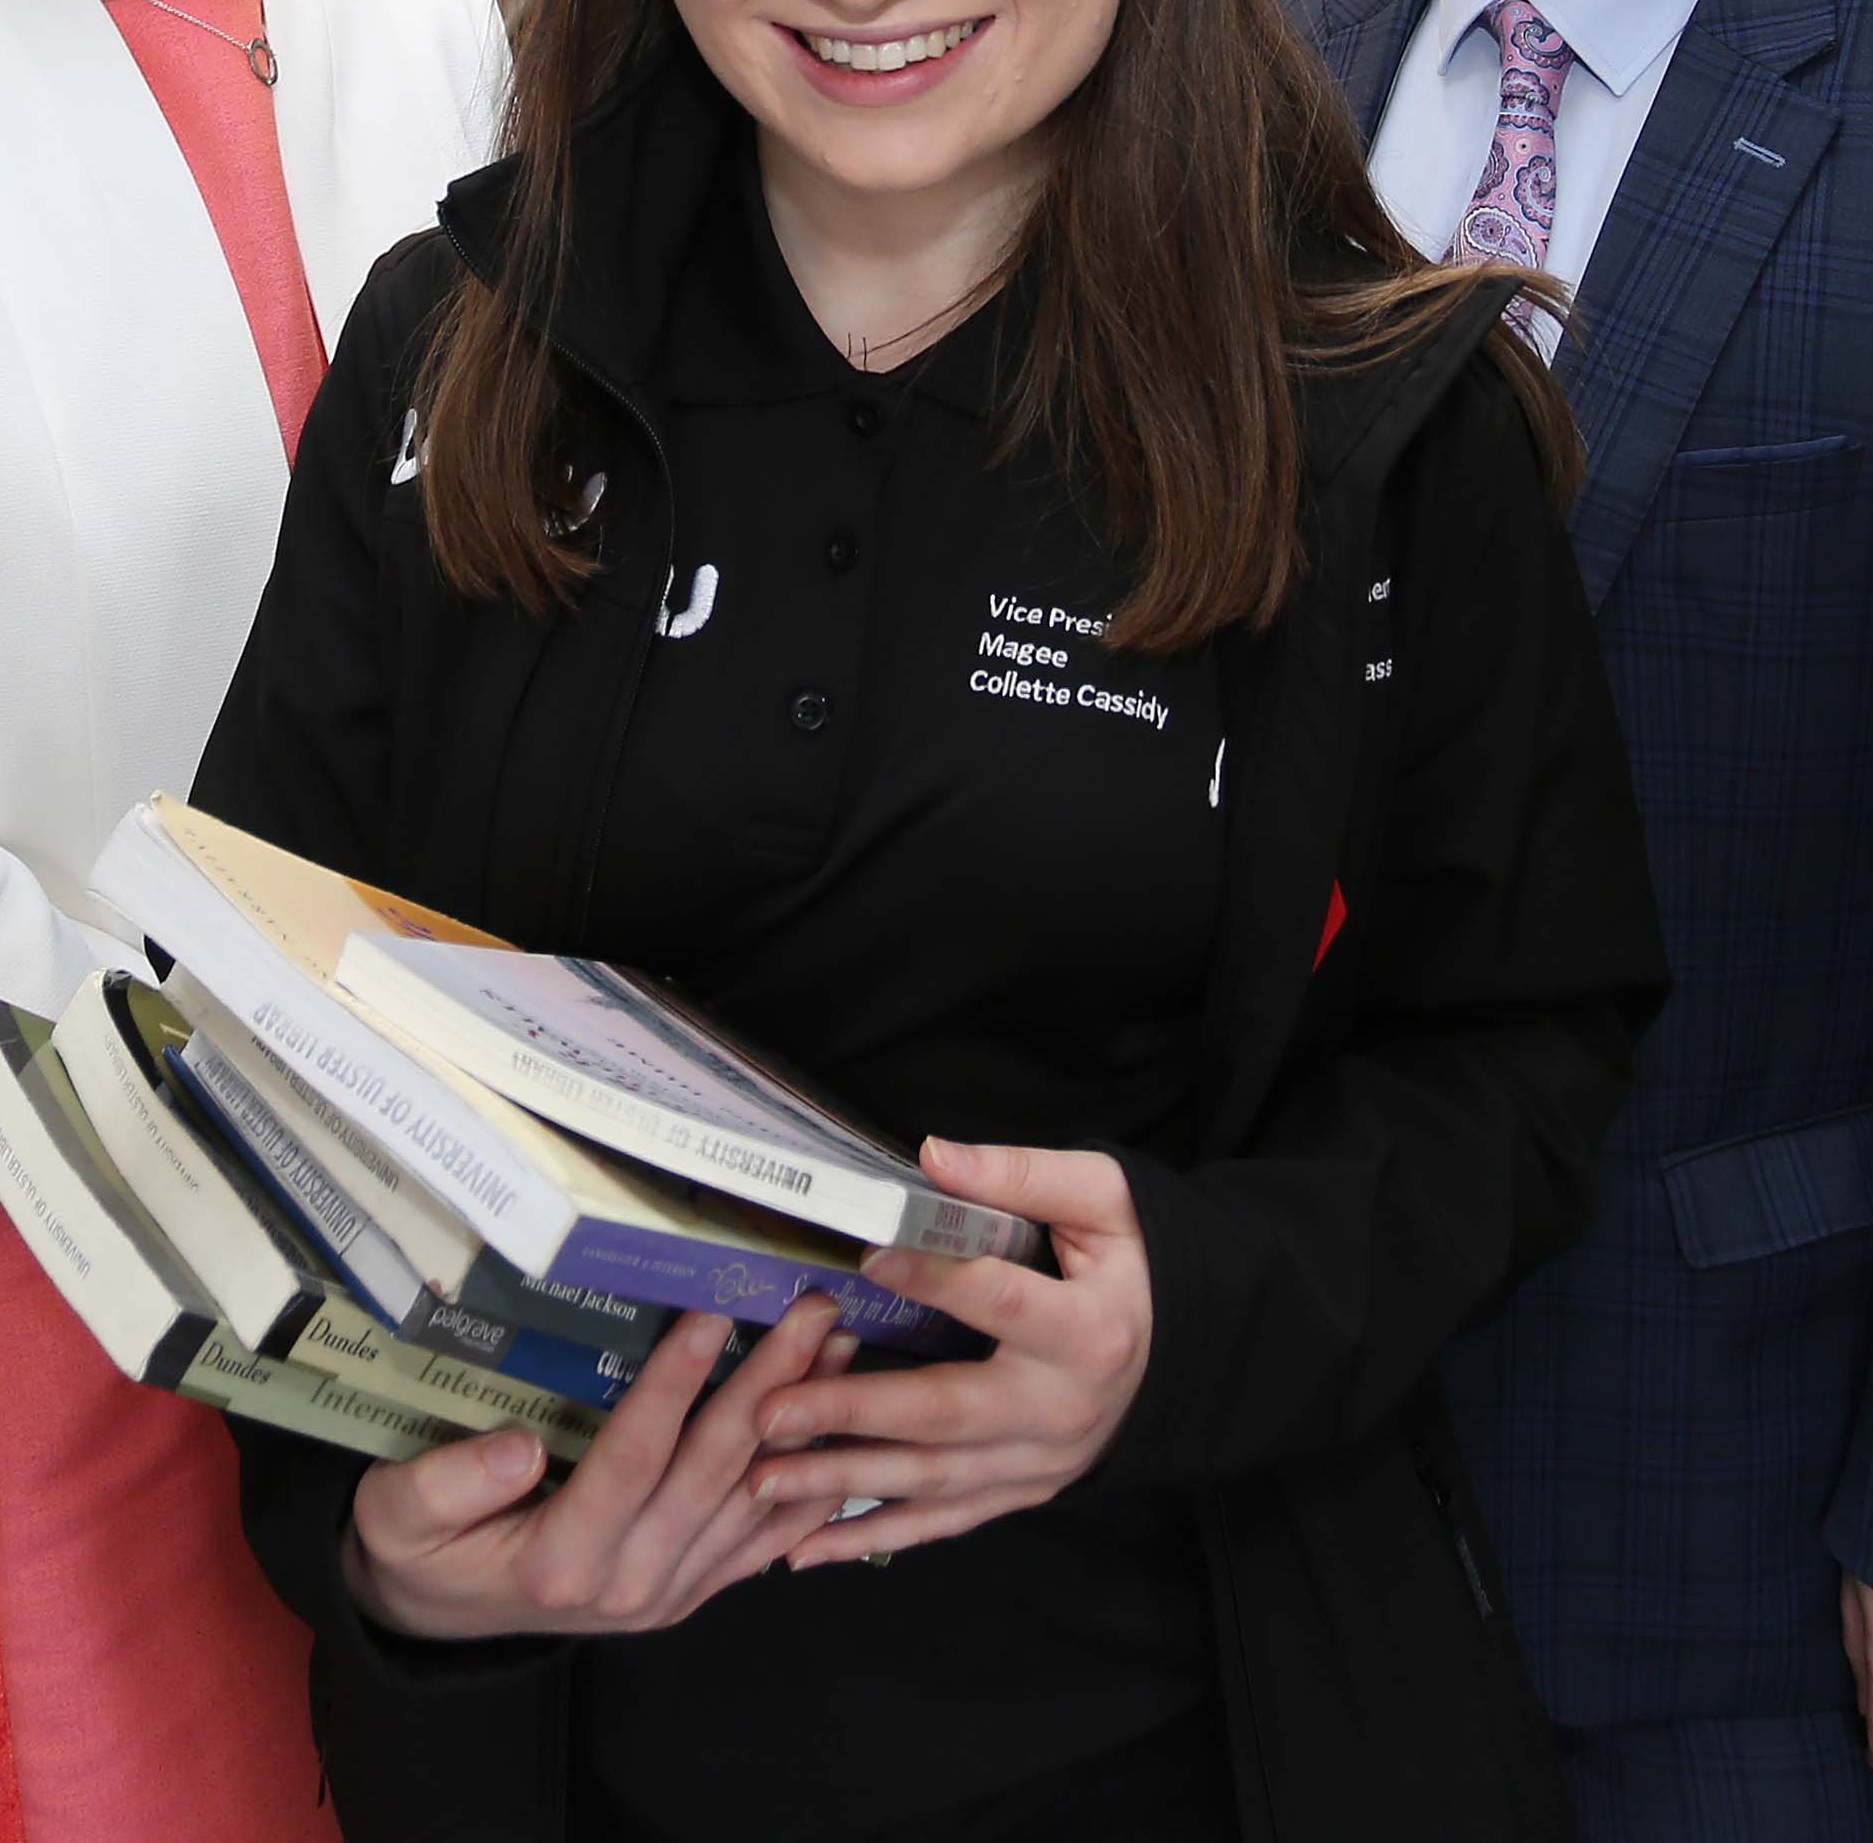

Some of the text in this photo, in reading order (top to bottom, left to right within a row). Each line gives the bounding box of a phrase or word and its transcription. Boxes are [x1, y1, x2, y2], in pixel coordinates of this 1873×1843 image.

[988, 593, 1044, 626] Vice
[978, 631, 1069, 669] Magee
[968, 668, 1170, 731] Collette Cassidy
[7, 1154, 37, 1202] ULSTER
[241, 1105, 357, 1243] UNIVERSITY OF ULSTER
[695, 1135, 813, 1197] UNIVERSITY
[34, 1196, 47, 1219] OF
[44, 1212, 92, 1280] UNIVERSITY
[305, 1316, 380, 1363] Dundes
[427, 1305, 506, 1344] palgrave
[198, 1340, 273, 1387] Dundes
